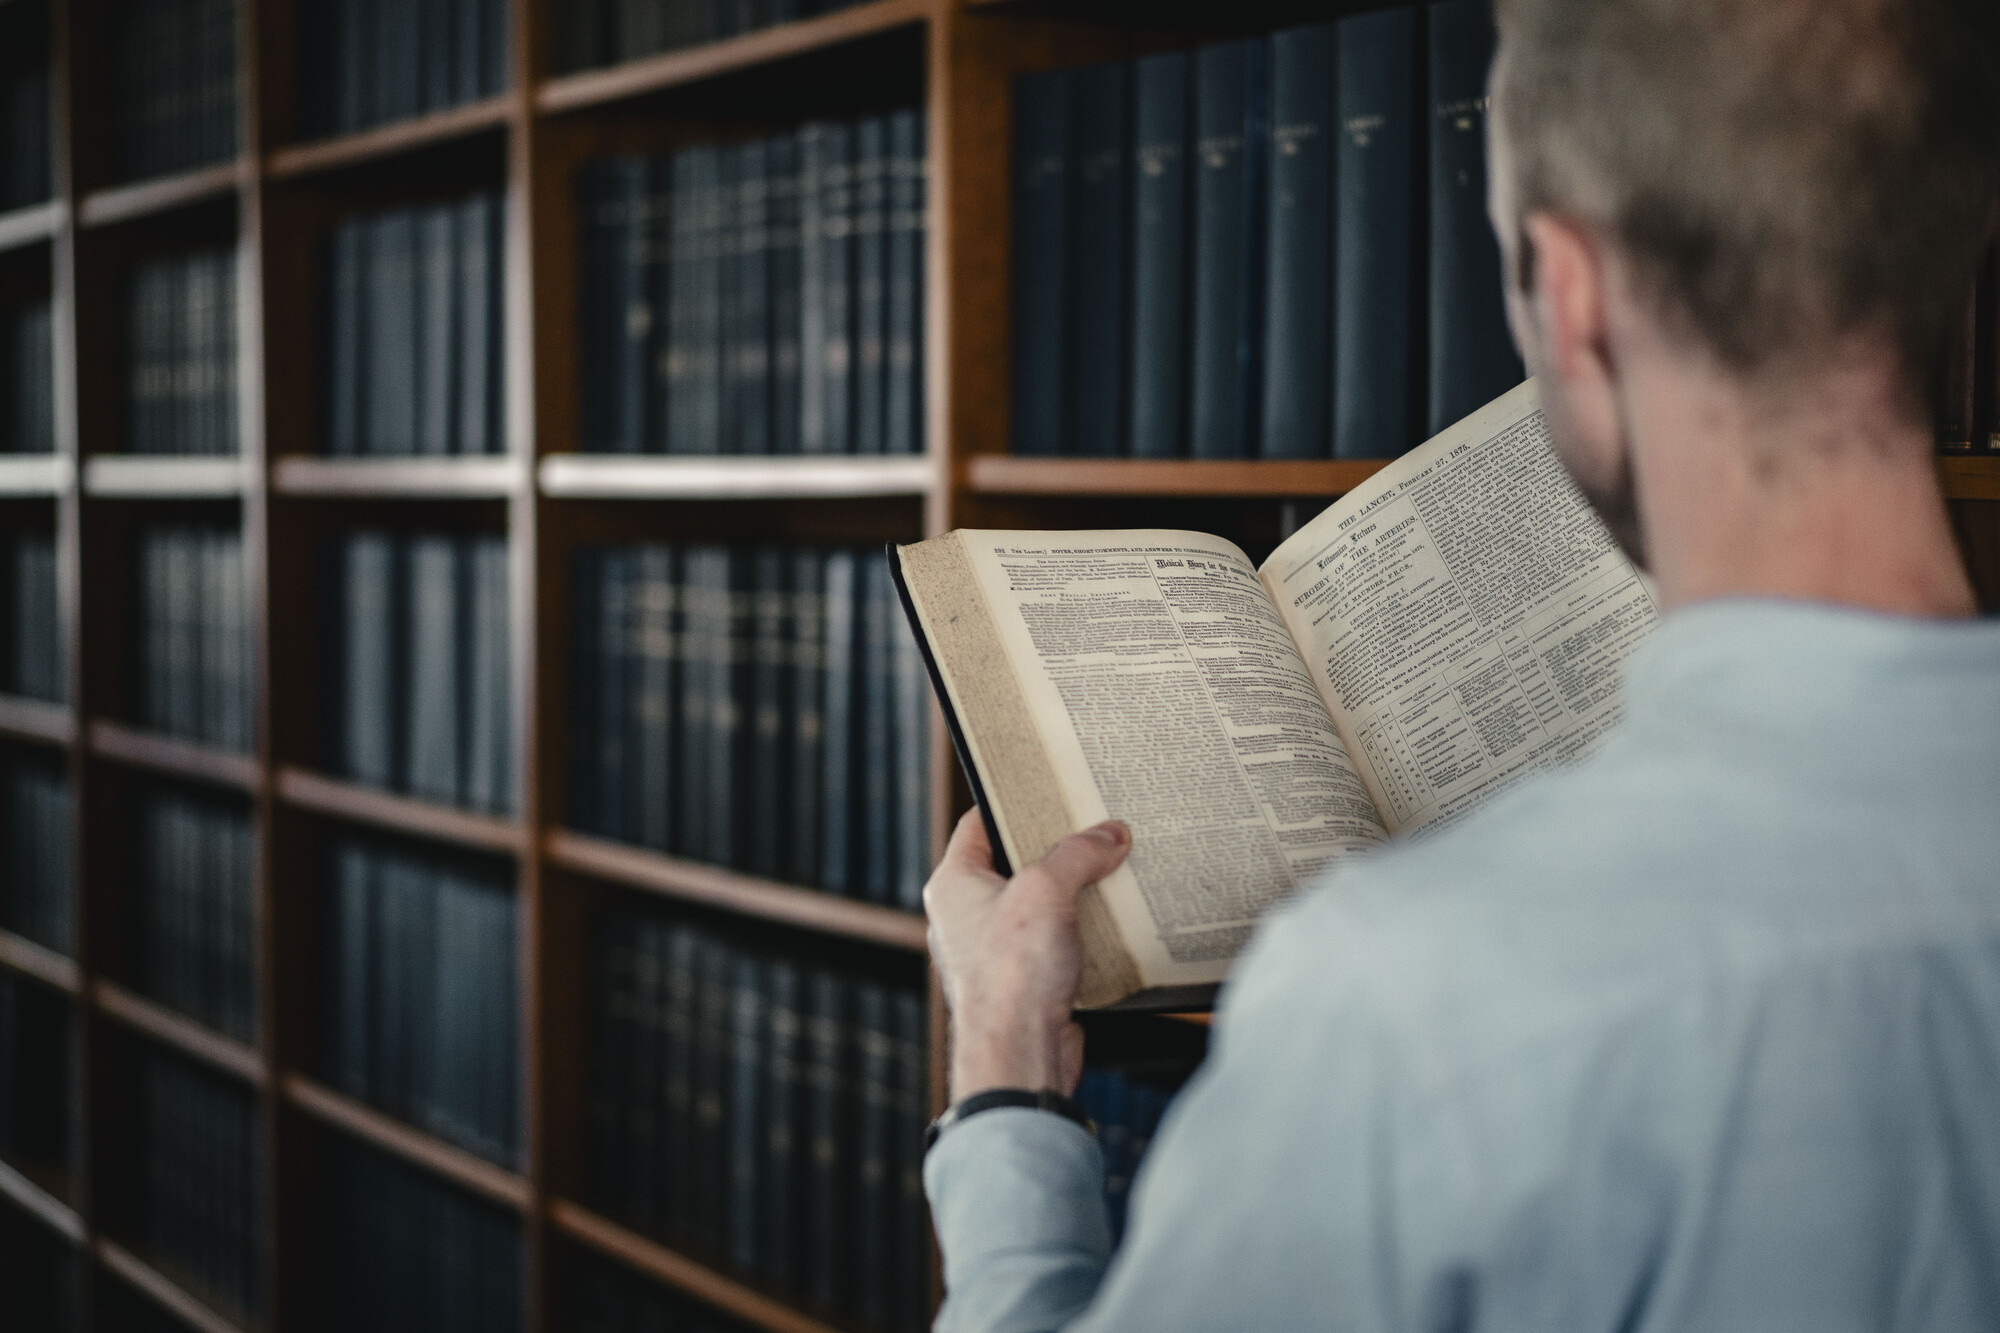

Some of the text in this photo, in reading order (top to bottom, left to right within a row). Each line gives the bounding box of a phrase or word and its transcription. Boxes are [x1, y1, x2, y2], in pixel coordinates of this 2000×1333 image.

[1431, 475, 1441, 484] and
[1440, 470, 1450, 478] the
[1472, 449, 1484, 459] that
[1484, 439, 1501, 452] wound,
[1500, 433, 1510, 442] the
[1436, 479, 1446, 488] the
[1445, 472, 1458, 483] time
[1462, 463, 1472, 472] the
[1494, 444, 1504, 452] the
[1520, 428, 1530, 436] the
[1337, 514, 1356, 530] THE
[1358, 488, 1395, 516] LANCET,
[1434, 456, 1448, 468] 27,
[1448, 441, 1470, 459] 1875.
[1349, 522, 1378, 544] Lectures
[1376, 532, 1407, 553] OPERATIONS
[1154, 559, 1184, 569] Medical
[1292, 575, 1331, 607] SURGERY
[1333, 562, 1346, 575] OF
[1349, 544, 1369, 561] THE
[1372, 514, 1418, 546] ARTERIES.
[1345, 572, 1355, 581] THE
[1377, 549, 1389, 559] AND
[1389, 539, 1406, 551] OTHER
[1362, 571, 1379, 584] Society
[1378, 567, 1385, 575] of
[1383, 557, 1403, 571] London,
[1365, 563, 1377, 572] AND
[1336, 607, 1343, 615] C.
[1350, 576, 1386, 603] MAUNDER,
[1387, 598, 1398, 607] AND
[1398, 592, 1409, 600] THE
[1349, 605, 1374, 625] LECTURE
[1368, 693, 1385, 706] TABLE
[1384, 688, 1392, 696] OF
[1493, 622, 1502, 630] OF
[1526, 603, 1533, 611] IN
[1533, 593, 1550, 606] THEIR
[1579, 570, 1588, 578] ON
[1588, 563, 1600, 573] THE
